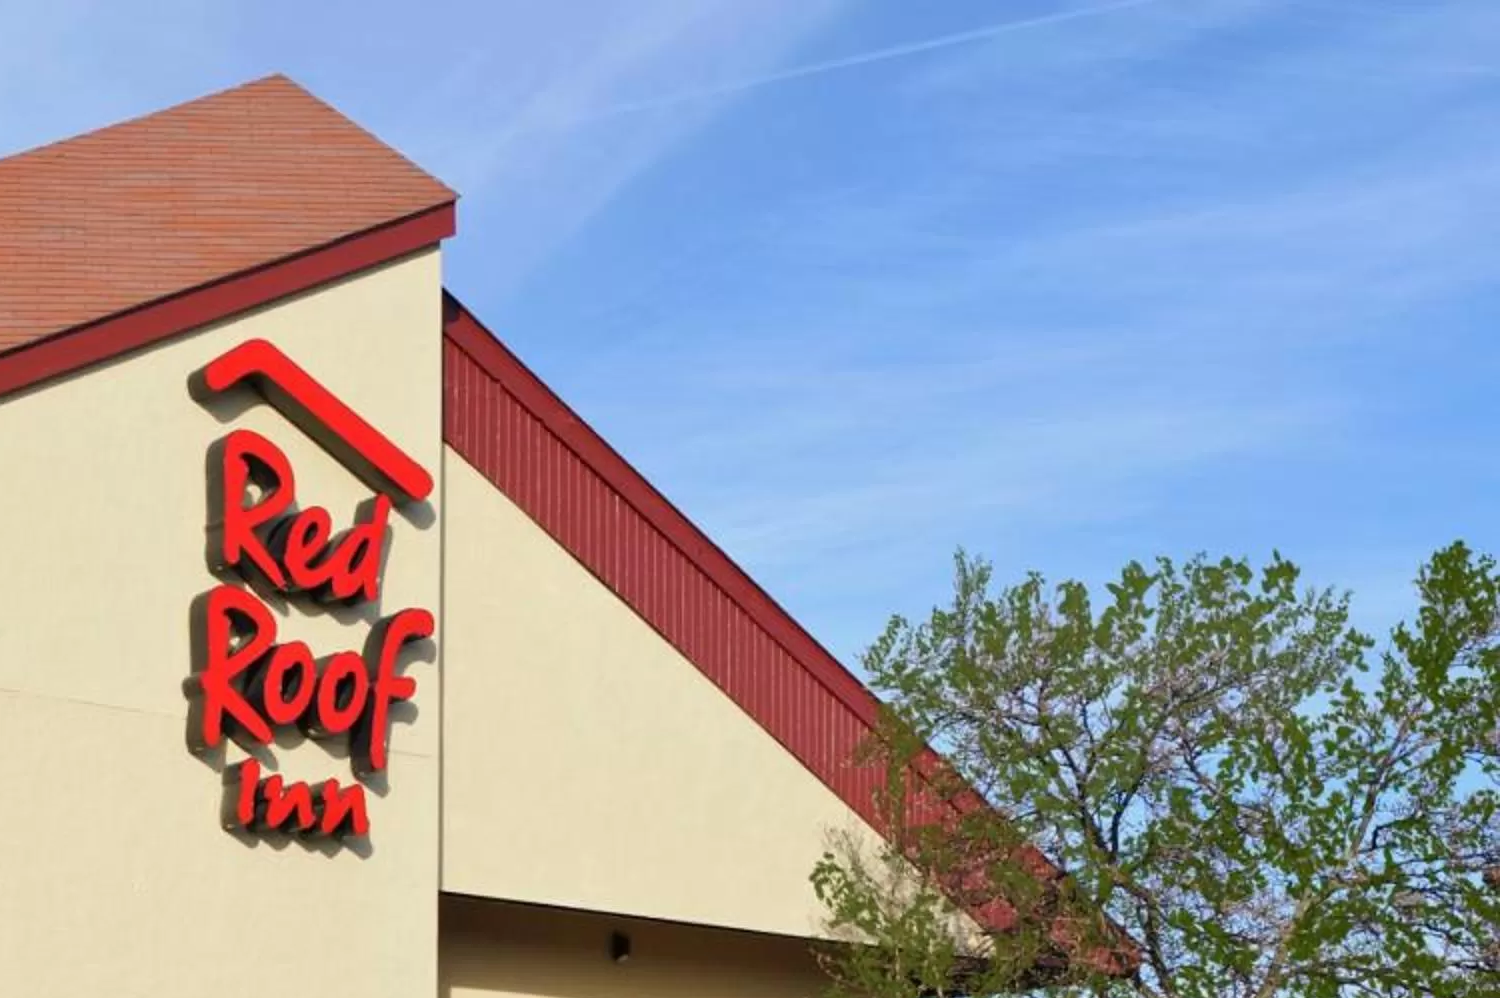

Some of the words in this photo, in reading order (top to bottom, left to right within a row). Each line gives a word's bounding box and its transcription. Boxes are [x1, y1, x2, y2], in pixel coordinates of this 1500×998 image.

[223, 429, 392, 601] Red
[200, 583, 435, 769] Roof
[238, 757, 370, 834] Inn
